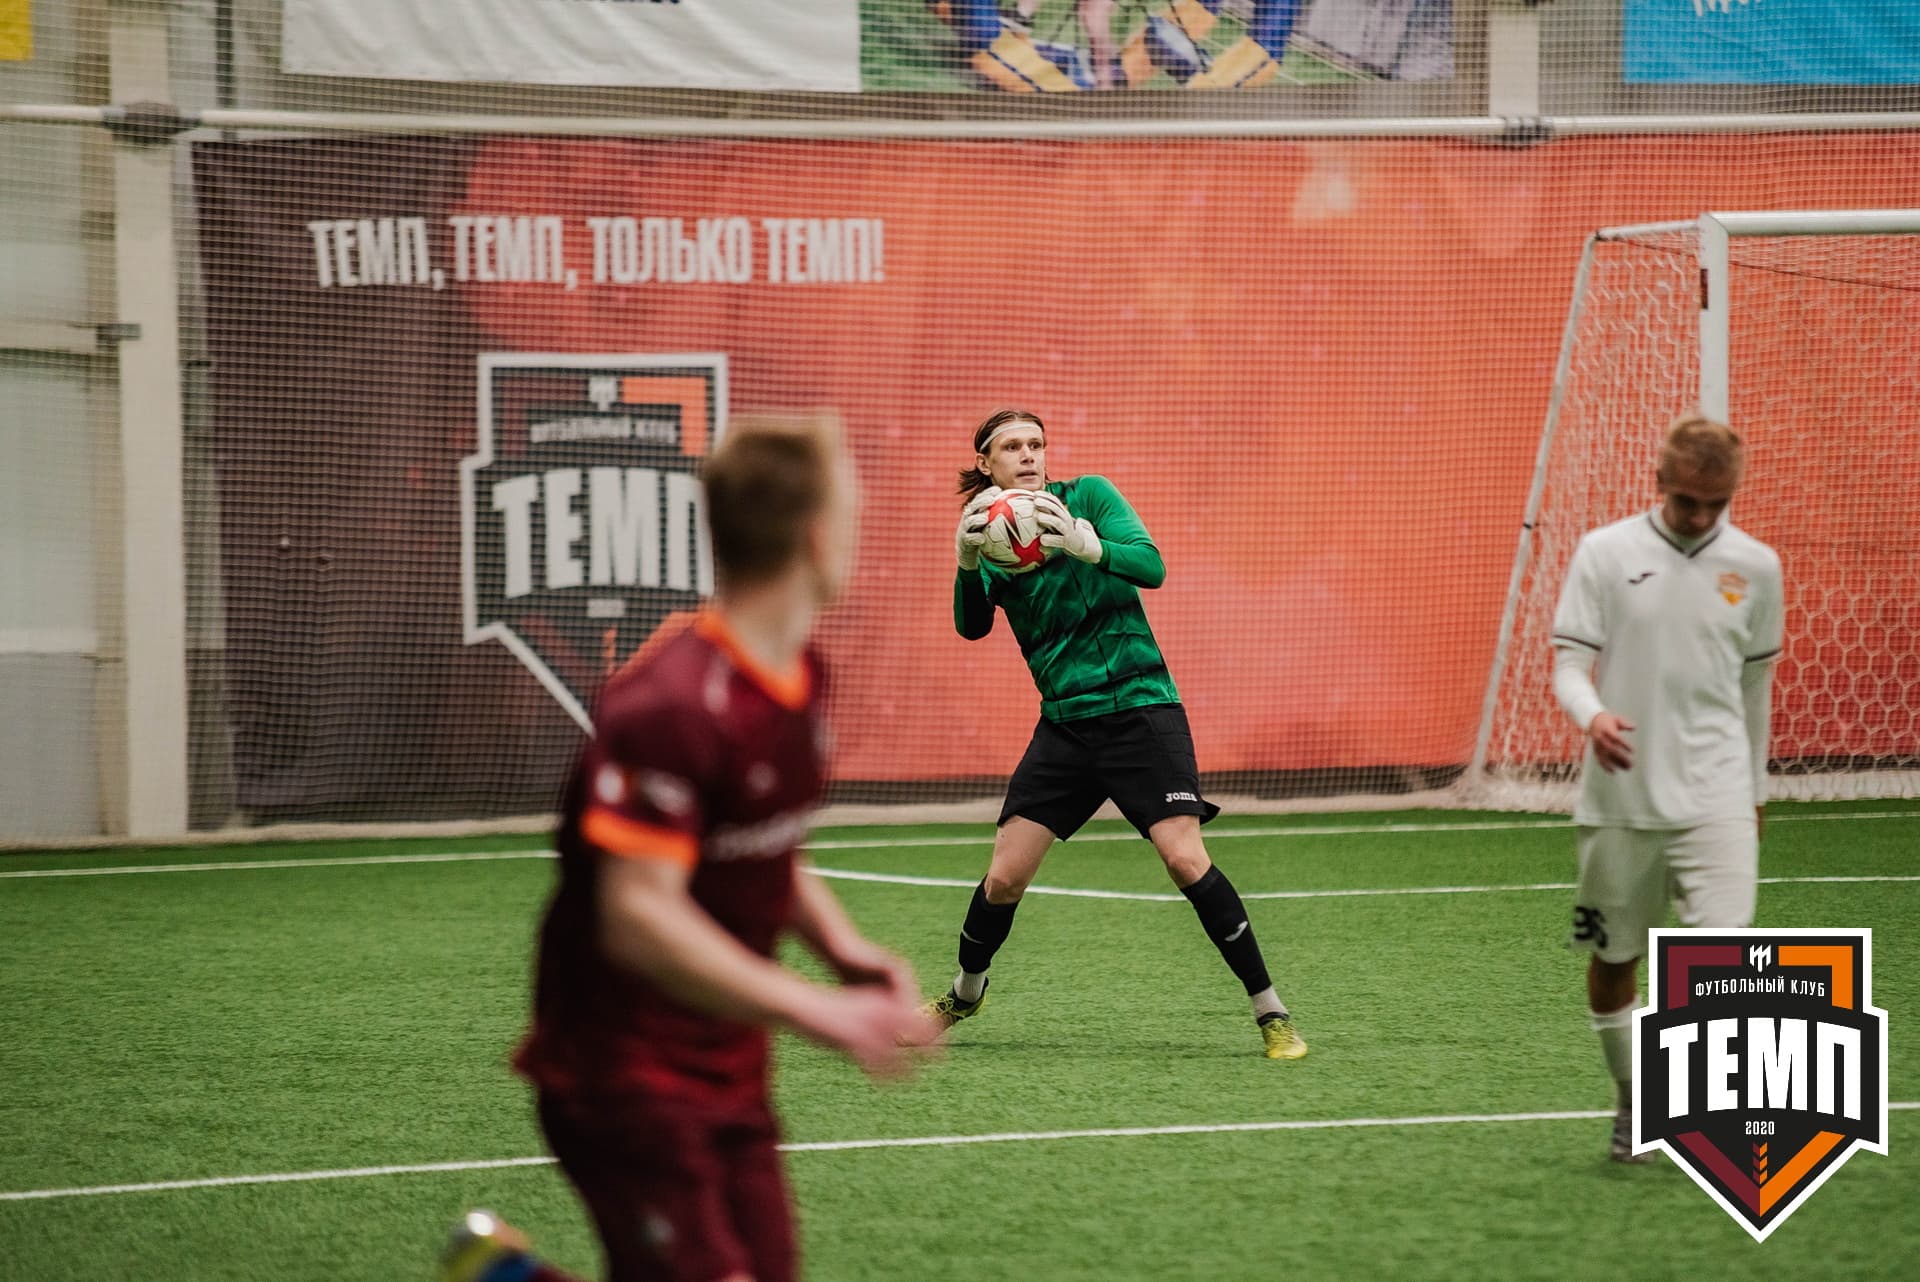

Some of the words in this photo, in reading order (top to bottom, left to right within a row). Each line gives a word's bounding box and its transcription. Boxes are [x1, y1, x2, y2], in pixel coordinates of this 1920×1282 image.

[307, 216, 446, 291] ТЕМП,
[449, 215, 579, 291] ТЕМП,
[586, 215, 752, 284] ТОЛЬКО
[761, 217, 886, 284] ТЕМП!
[492, 465, 716, 600] ТЕМП
